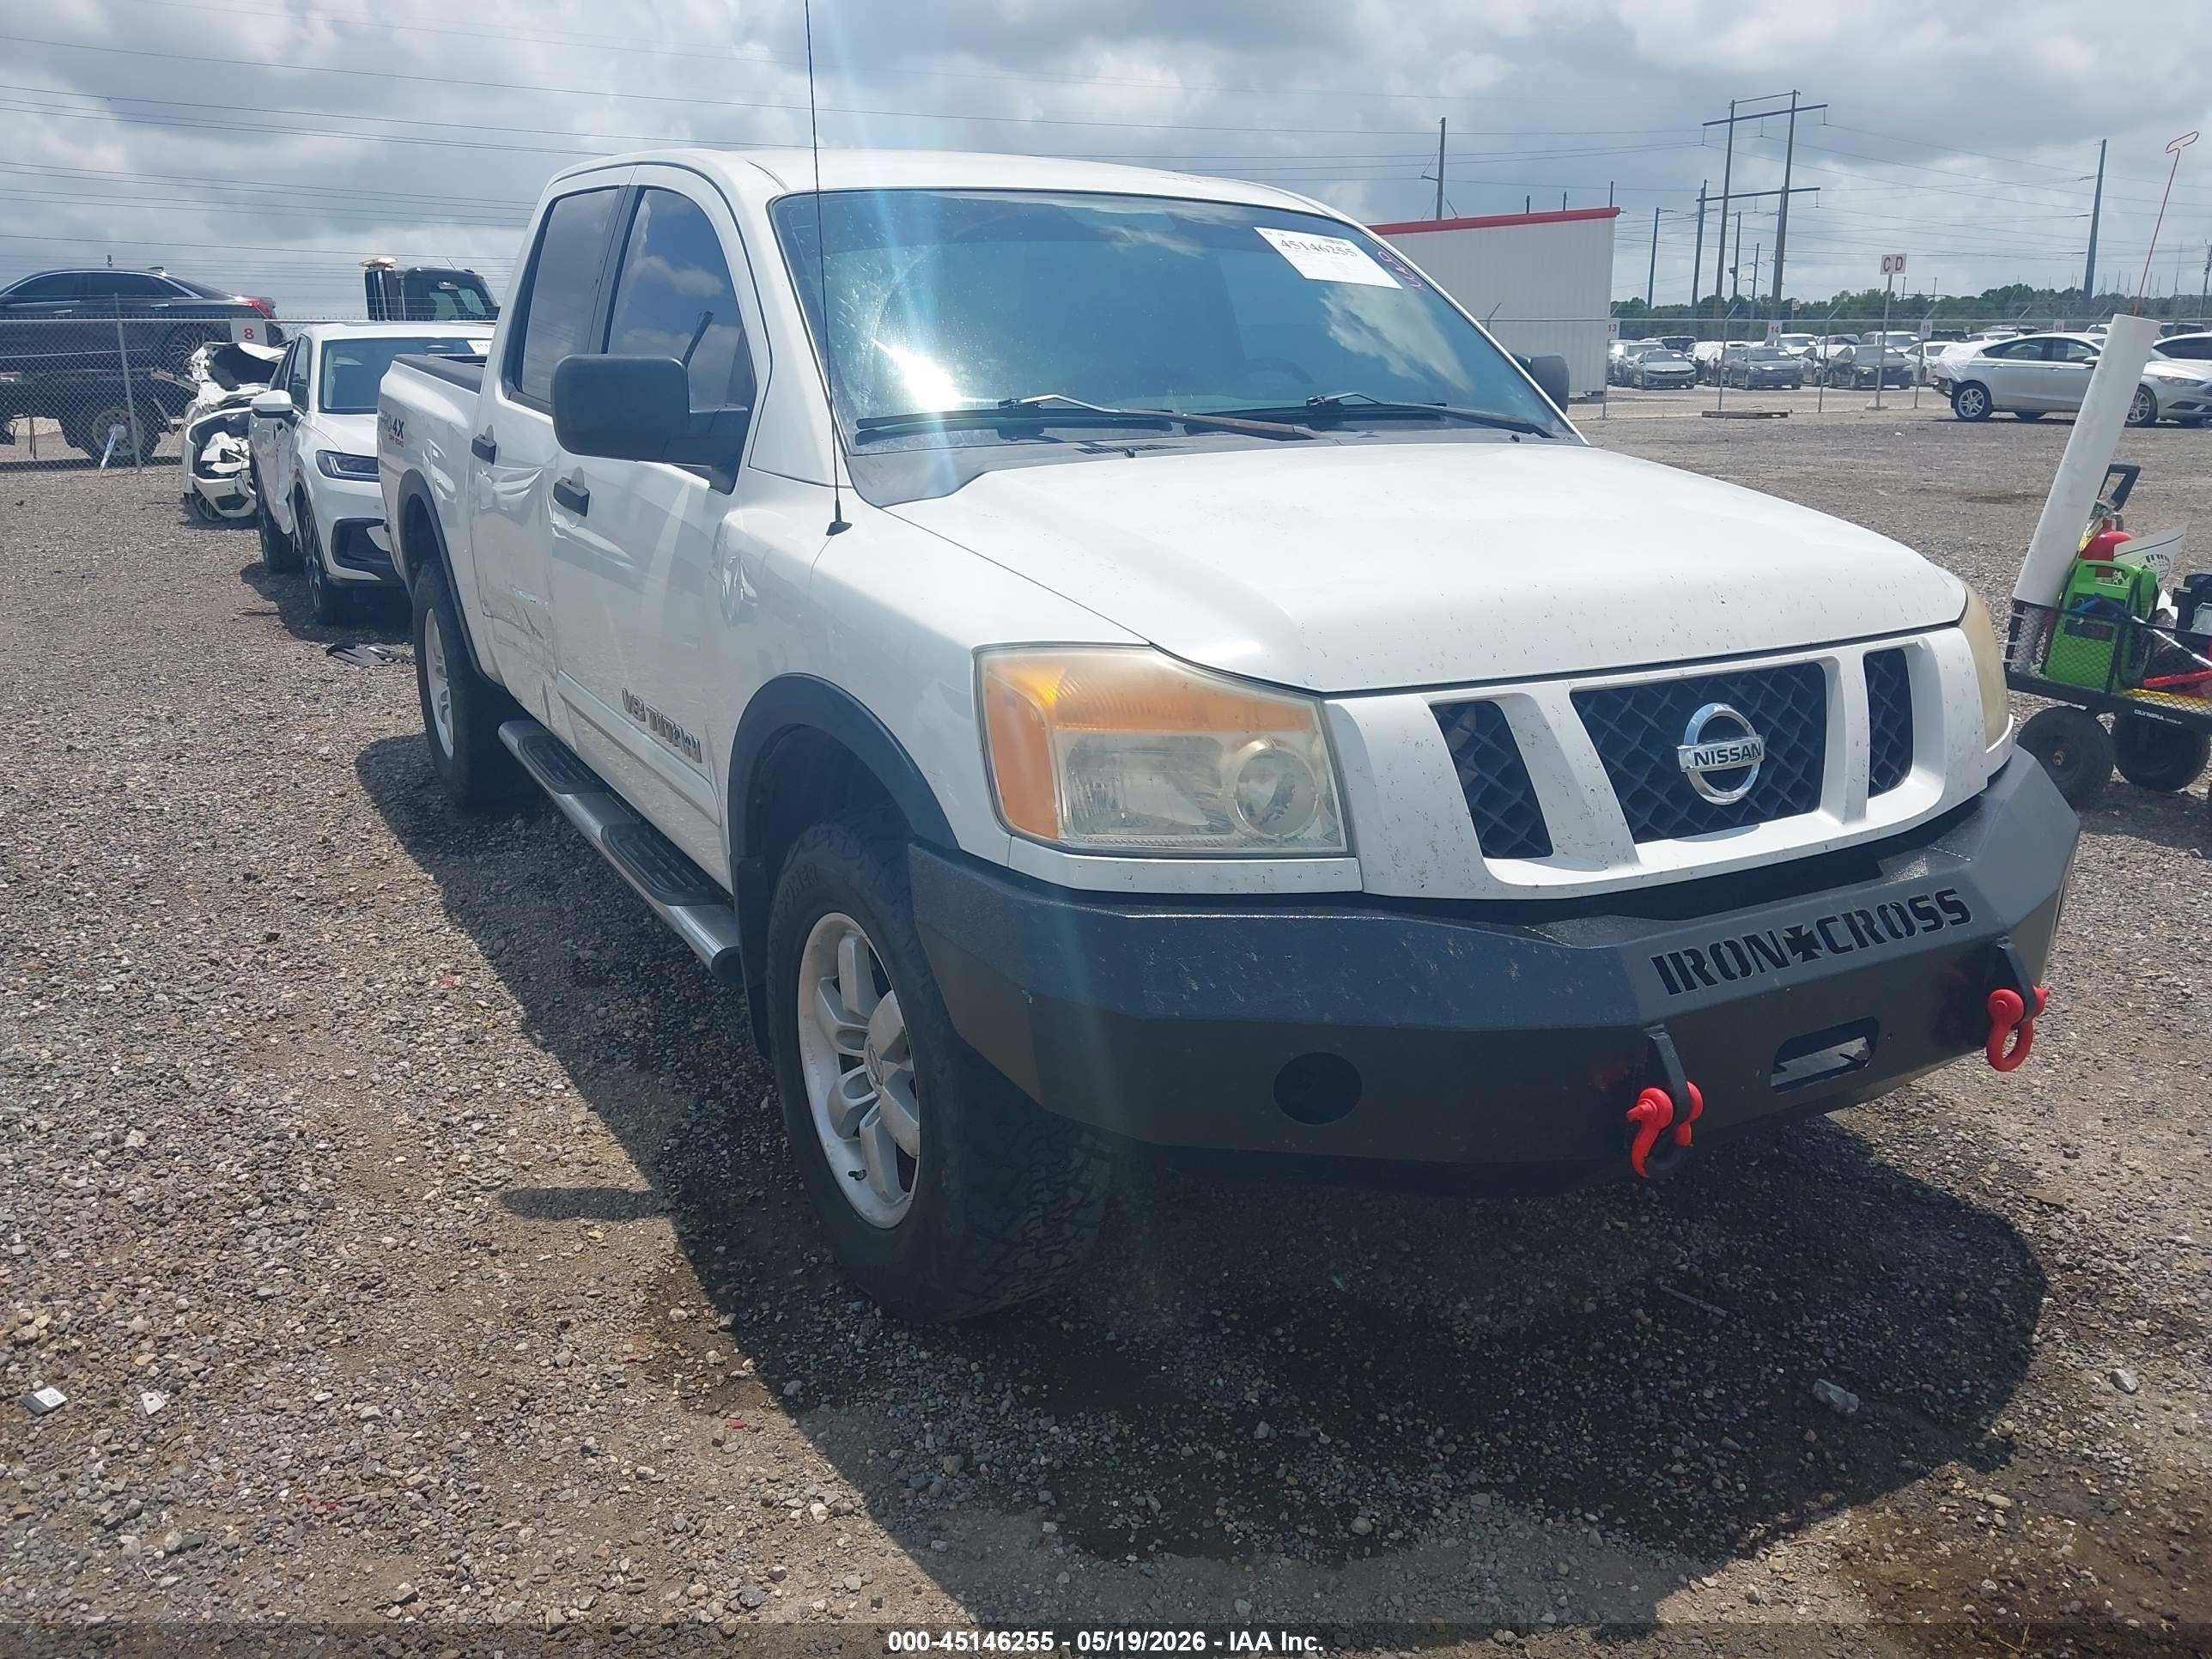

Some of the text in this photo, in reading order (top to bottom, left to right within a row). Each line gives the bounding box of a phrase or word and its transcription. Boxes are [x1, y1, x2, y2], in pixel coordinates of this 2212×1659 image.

[1281, 240, 1358, 257] 45146255
[1884, 257, 1903, 271] C D
[244, 328, 254, 340] 8
[1608, 324, 1617, 332] 13
[621, 687, 702, 763] V8 TITAN
[1694, 741, 1762, 767] NISSAN
[1650, 888, 1973, 996] IRON CROSS
